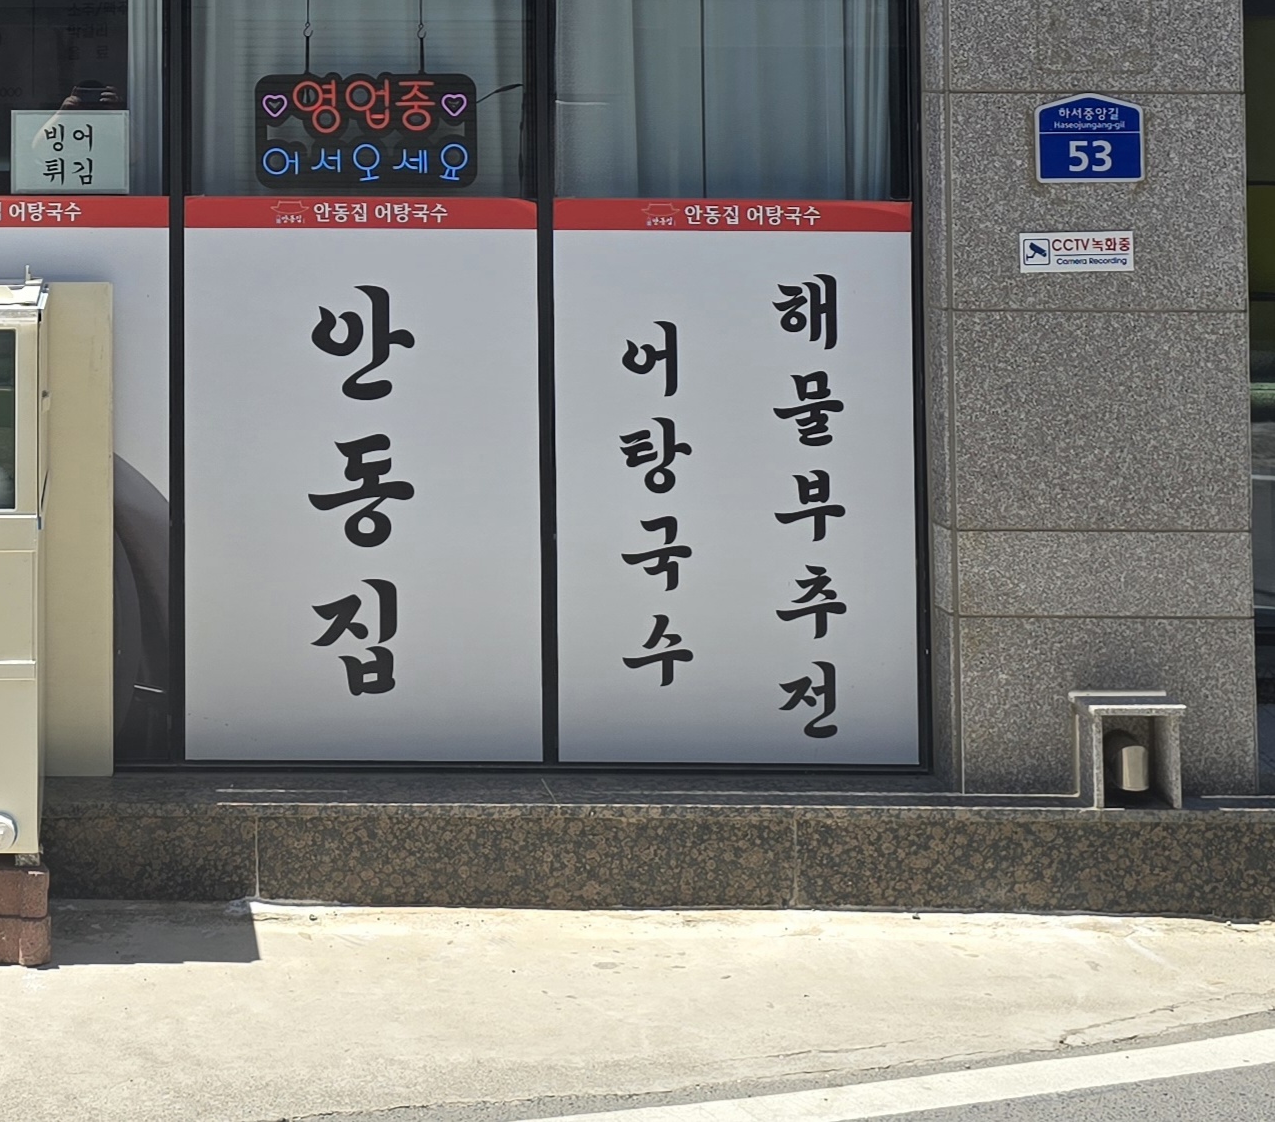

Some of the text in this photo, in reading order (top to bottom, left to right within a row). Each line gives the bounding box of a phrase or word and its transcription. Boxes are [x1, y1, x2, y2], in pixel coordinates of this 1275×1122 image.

[292, 79, 436, 133] 영업중
[1058, 107, 1119, 120] 하서중앙길
[43, 123, 94, 153] 빙어
[1054, 121, 1125, 131] Haseojungang-gil
[262, 143, 469, 181] 어서오세요
[1068, 140, 1113, 172] 53
[42, 157, 94, 186] 튀김
[9, 201, 82, 222] 어탕국수
[313, 203, 448, 223] 안동집 어탕국수
[684, 205, 822, 226] 안동집 어탕국수
[1051, 237, 1131, 252] CCTV 녹화중
[1056, 257, 1128, 266] Camera Recording
[308, 285, 415, 696] 안동집
[619, 321, 694, 687] 어탕국수
[772, 274, 847, 738] 해물부추전
